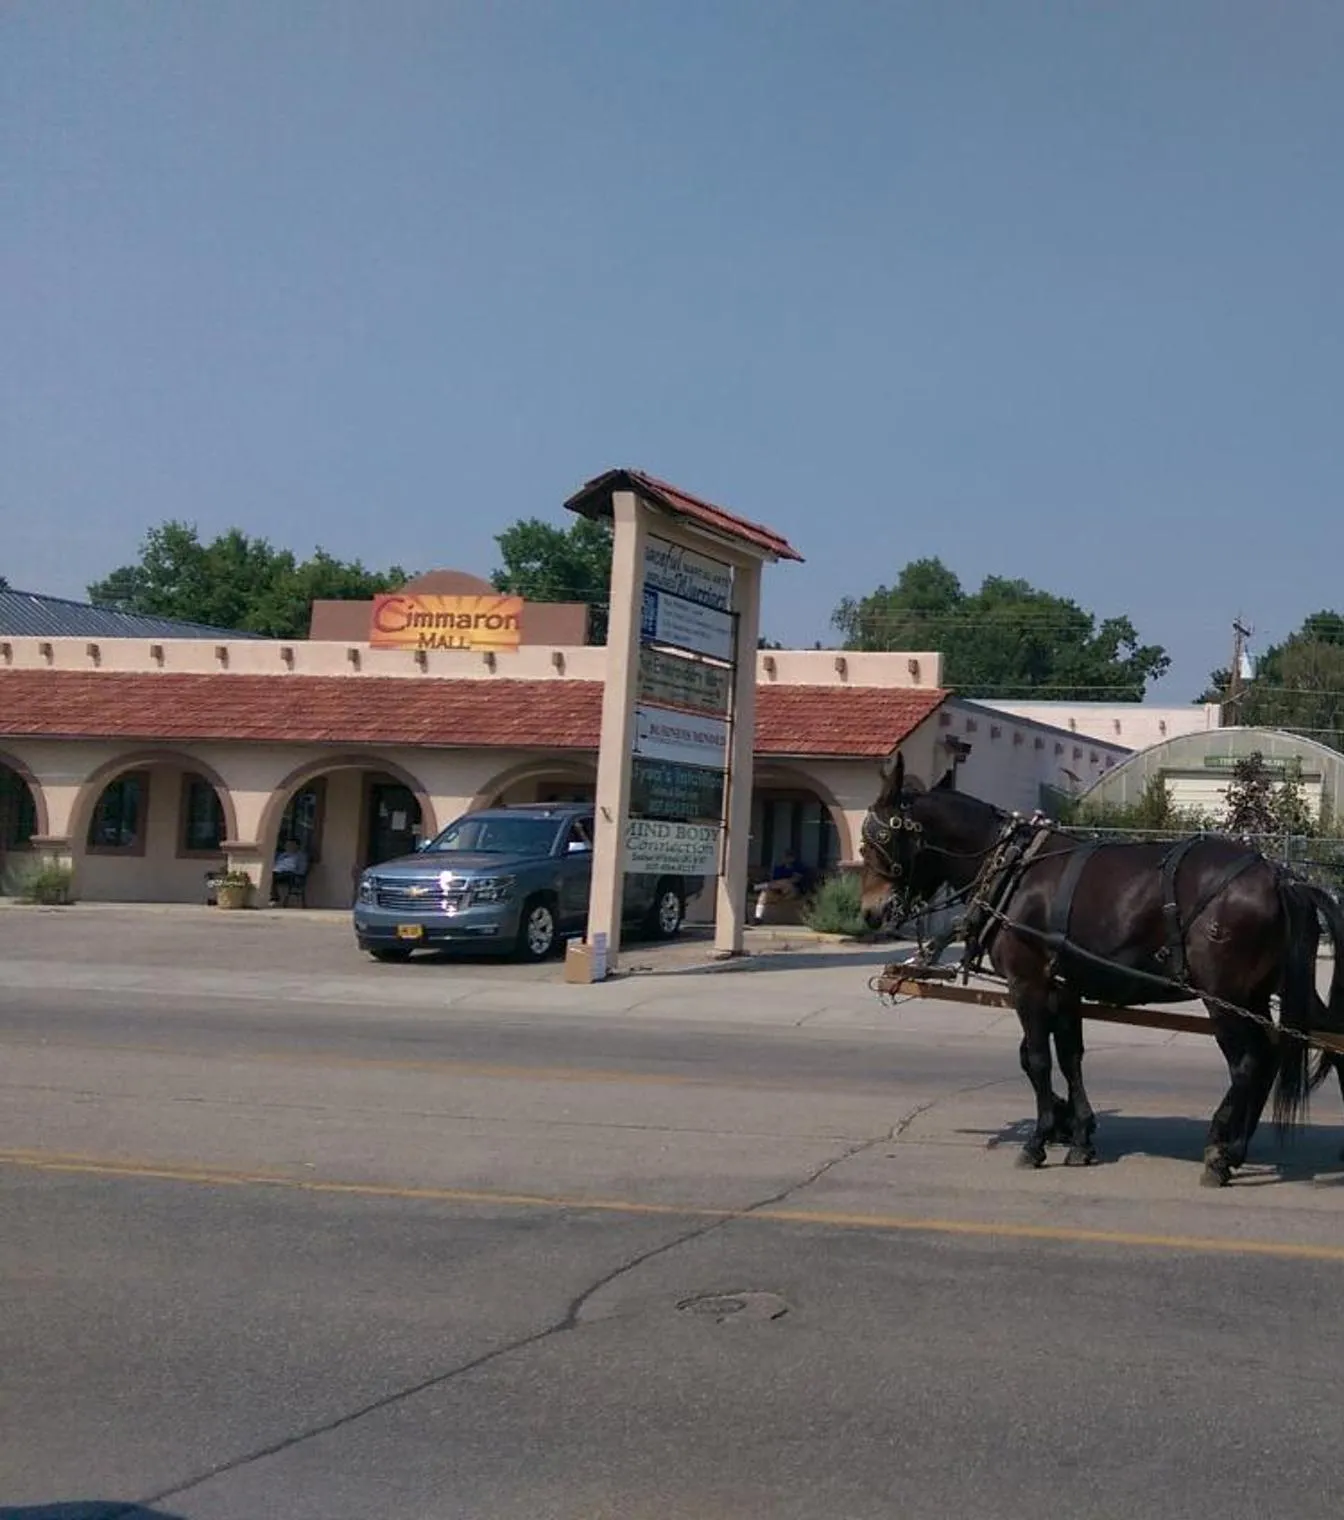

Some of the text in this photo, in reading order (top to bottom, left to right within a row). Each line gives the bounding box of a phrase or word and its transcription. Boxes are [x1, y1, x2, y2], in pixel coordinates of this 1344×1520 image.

[374, 597, 520, 633] Cimmaron
[417, 631, 471, 650] MALL
[676, 826, 720, 842] BODY
